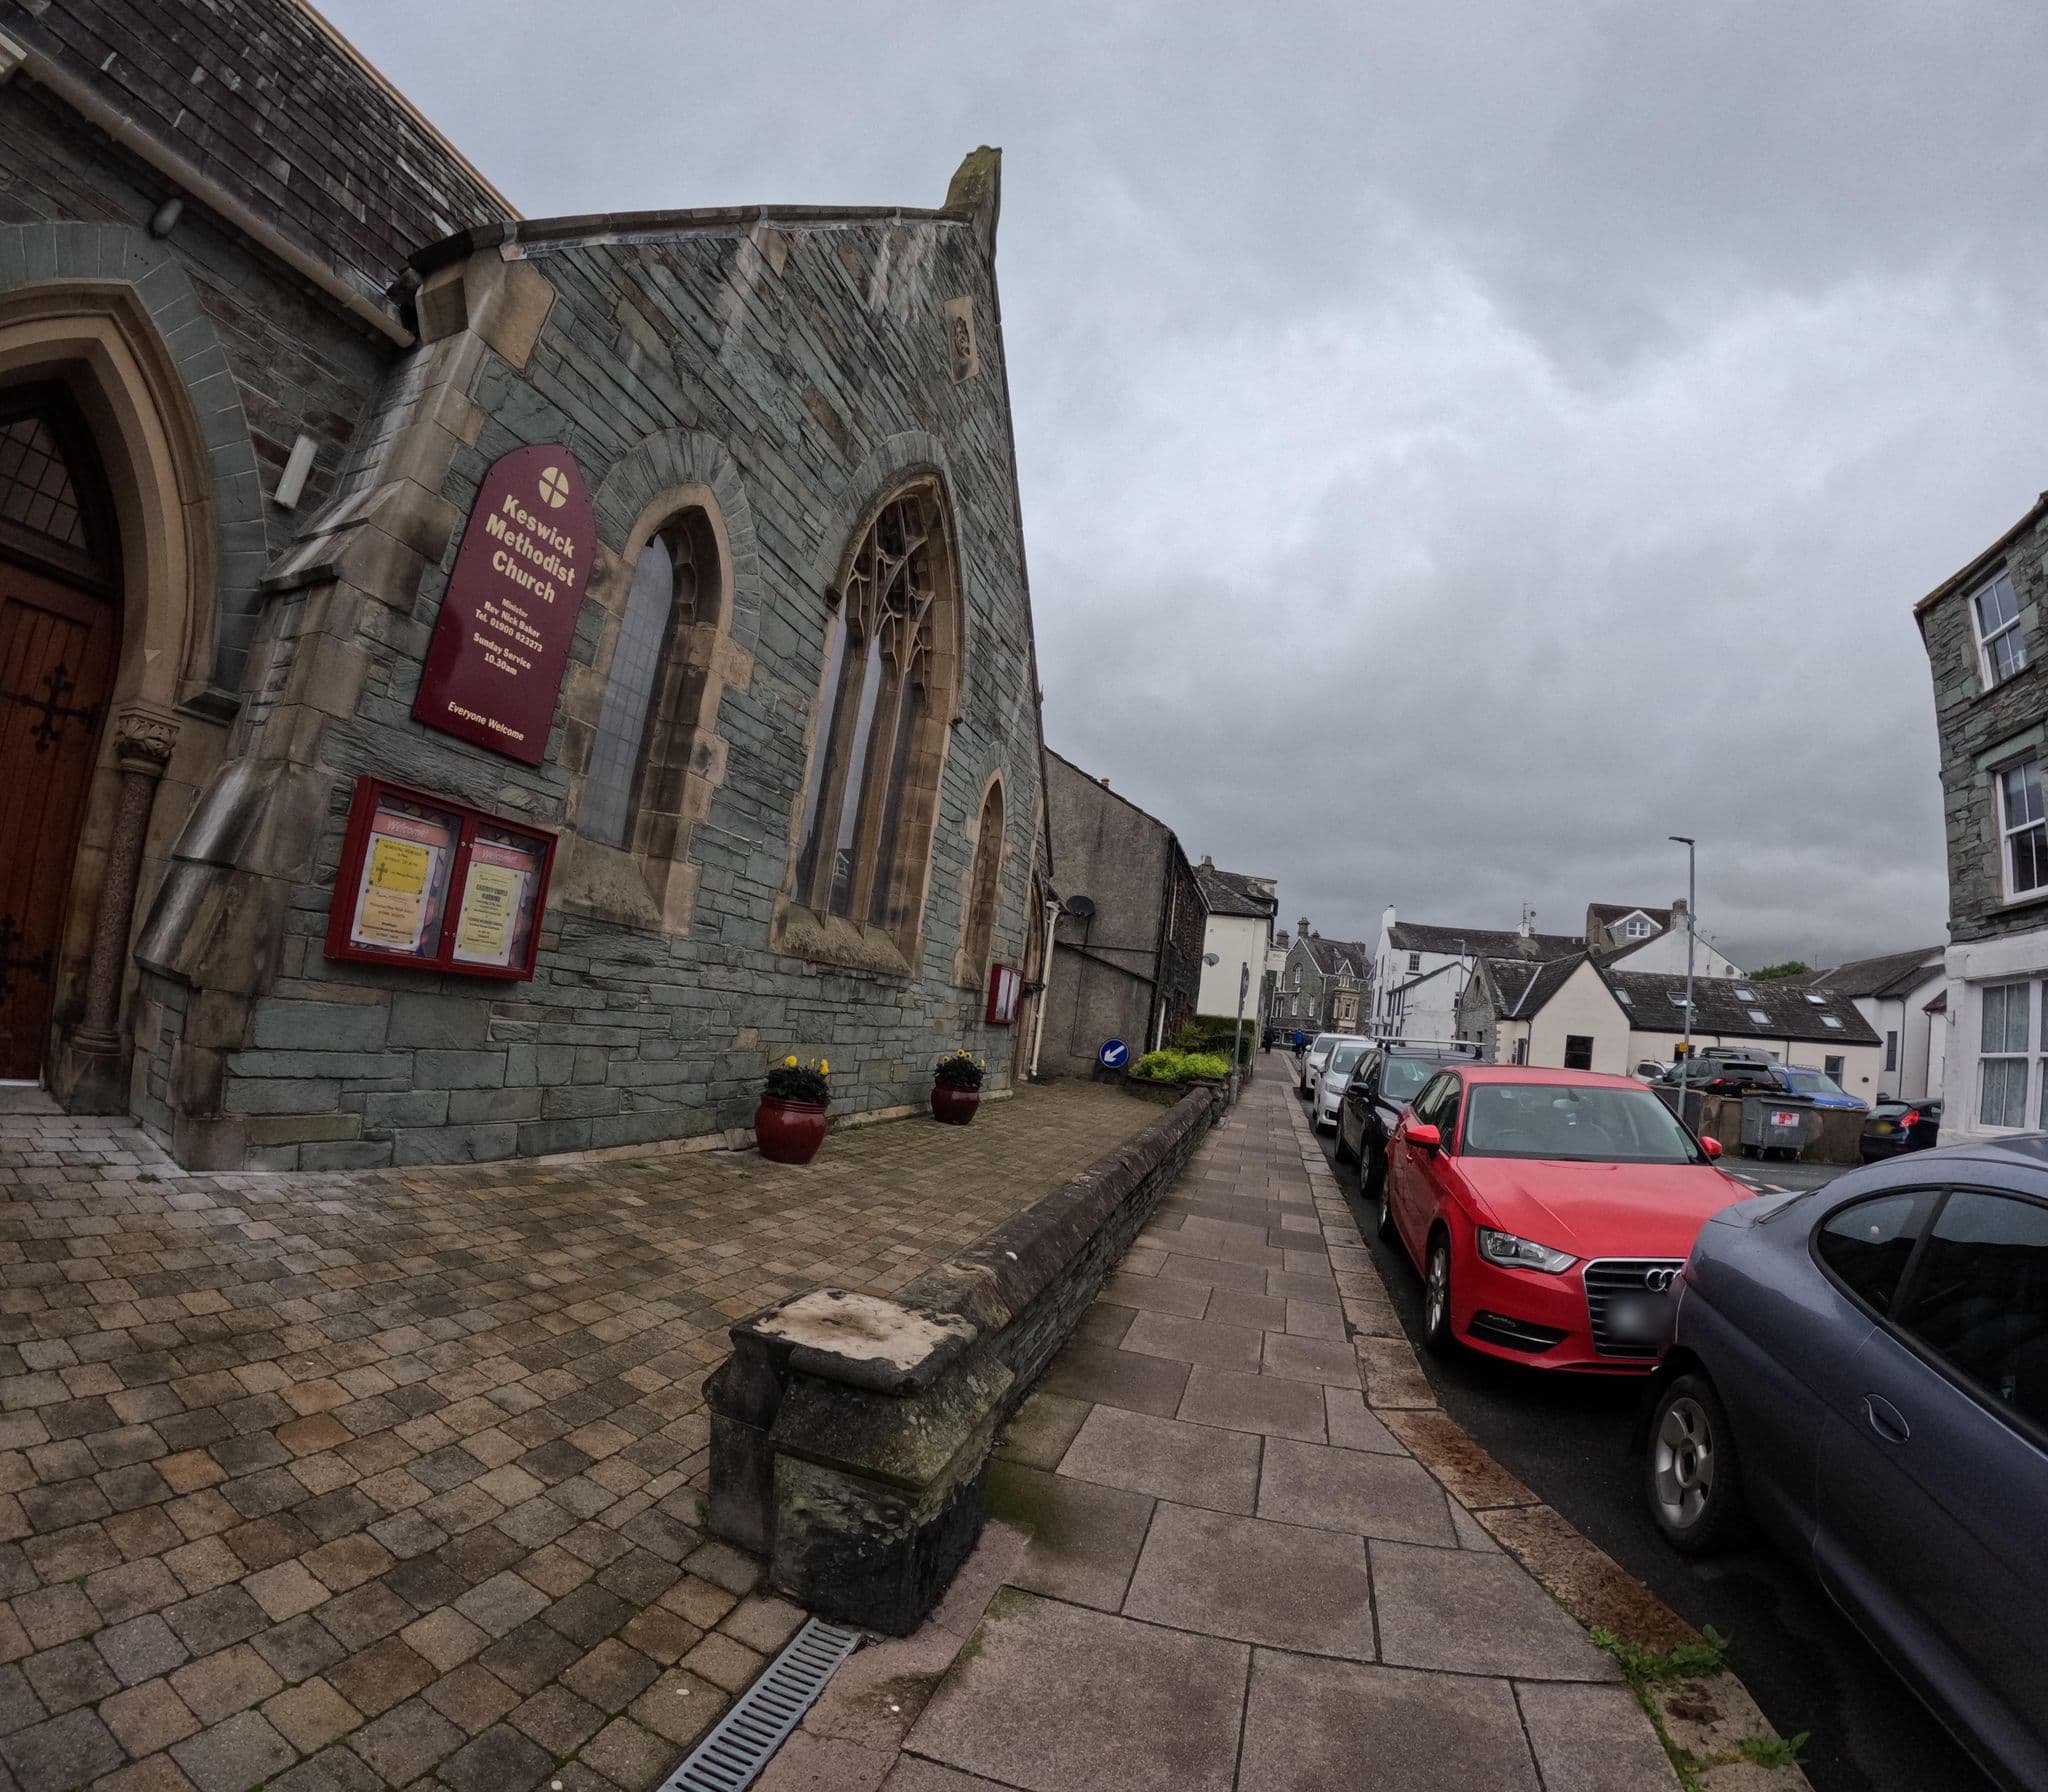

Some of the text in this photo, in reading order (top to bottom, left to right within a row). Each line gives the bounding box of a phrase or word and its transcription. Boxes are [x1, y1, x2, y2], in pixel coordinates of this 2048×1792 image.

[502, 494, 575, 559] Keswick
[485, 513, 575, 587] Methodist
[492, 550, 555, 603] Church
[484, 601, 540, 638] Rev Nick Baker
[501, 598, 528, 617] Minister
[490, 618, 514, 636] 01900
[473, 632, 531, 669] Sunday Service
[484, 653, 517, 675] 10.30am
[448, 701, 525, 741] Everyone Welcome
